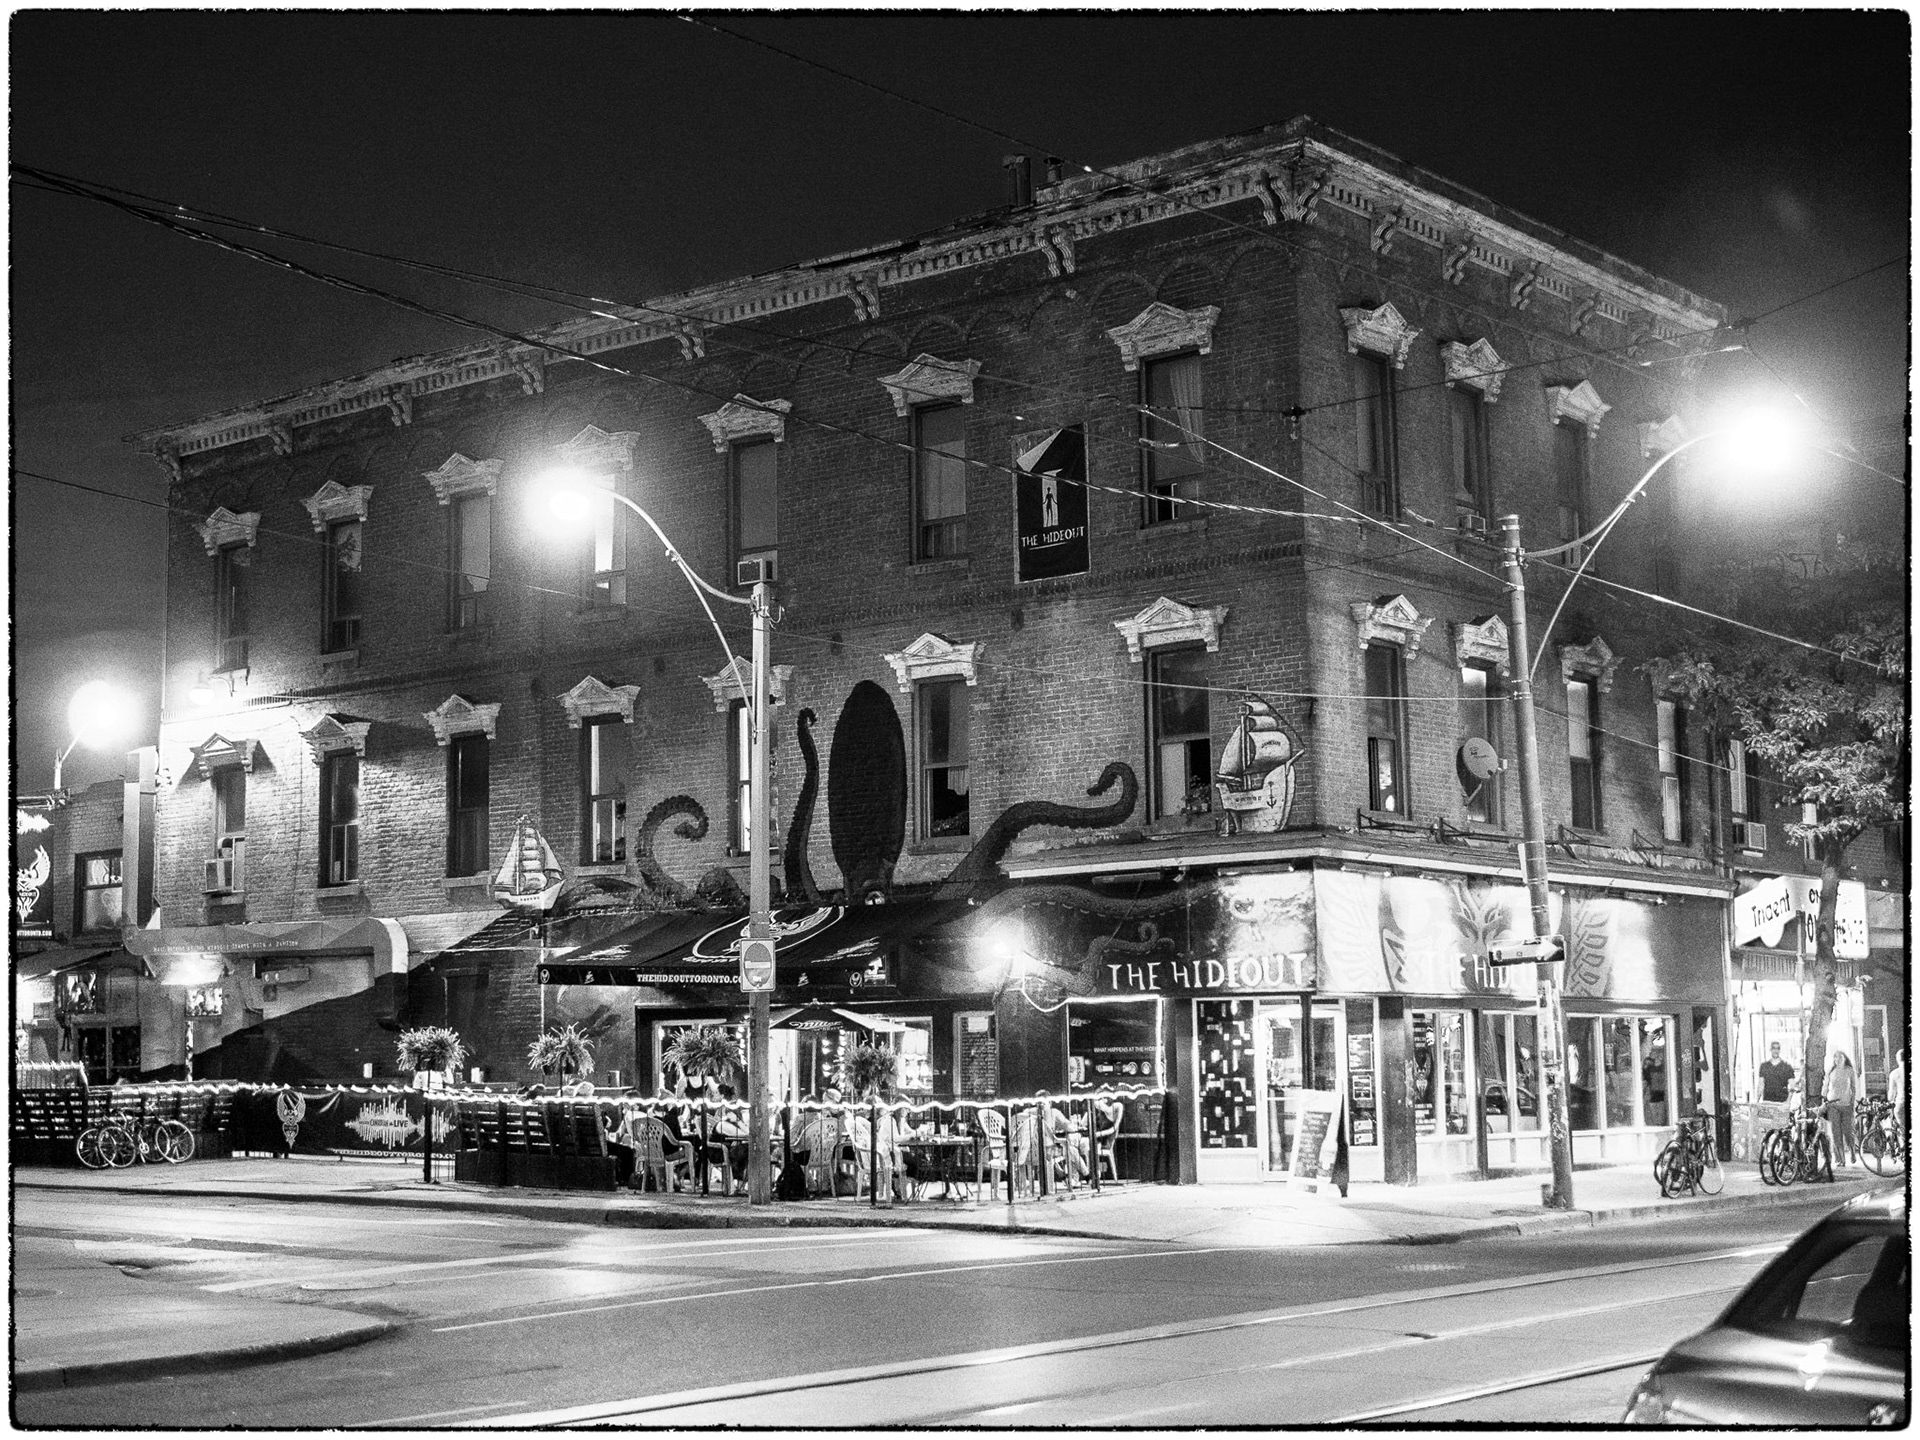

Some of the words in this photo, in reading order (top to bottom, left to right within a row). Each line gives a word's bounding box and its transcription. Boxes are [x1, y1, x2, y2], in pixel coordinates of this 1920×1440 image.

[1021, 534, 1039, 548] THE
[1042, 526, 1085, 544] HIDEOUT
[1751, 888, 1791, 928] Trident
[1107, 962, 1162, 991] THE
[1170, 952, 1308, 988] HIDEOUT
[789, 1019, 843, 1030] Miller
[393, 1119, 409, 1128] LIVE
